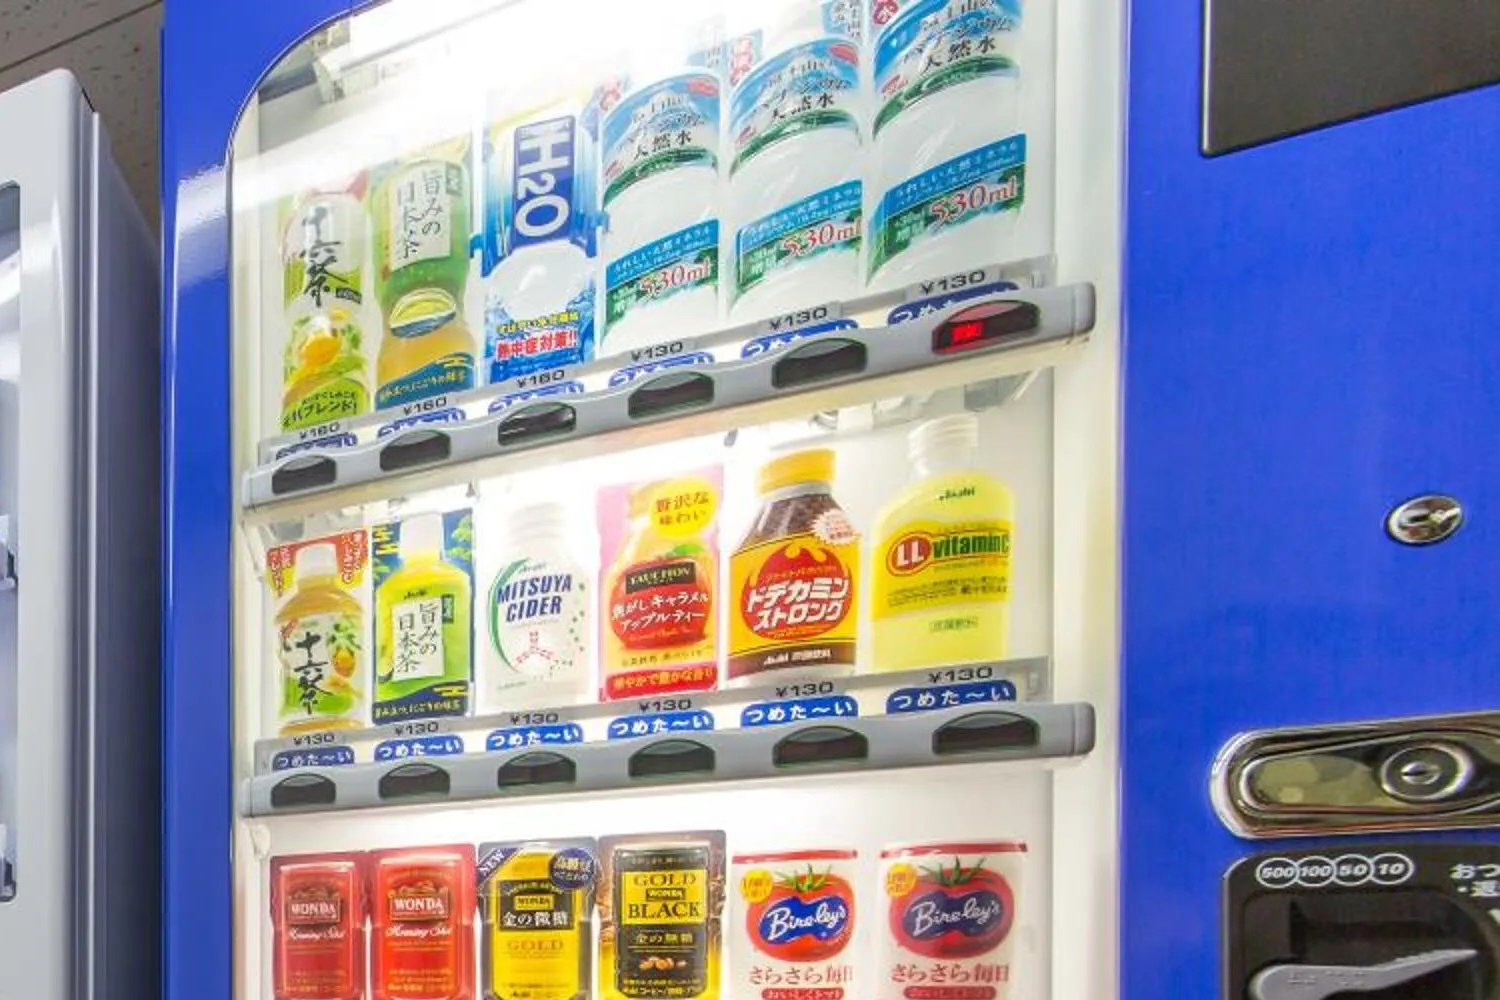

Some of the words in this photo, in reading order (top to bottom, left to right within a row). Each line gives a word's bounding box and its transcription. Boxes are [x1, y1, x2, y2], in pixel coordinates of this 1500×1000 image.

[515, 121, 571, 238] H2O
[931, 175, 1018, 221] 530ml
[301, 204, 348, 307] 十六茶
[920, 270, 986, 294] ¥130
[769, 307, 828, 331] ¥130
[631, 342, 683, 361] ¥130
[517, 370, 565, 388] ¥160
[403, 396, 448, 416] ¥160
[897, 541, 924, 566] LL
[497, 574, 574, 605] MITSUYA
[747, 577, 849, 613] ドデカミン
[506, 595, 563, 623] CIDER
[753, 599, 845, 632] ストロング
[419, 602, 440, 656] 旨みの
[396, 613, 421, 674] 日本茶
[293, 631, 335, 716] 十六茶
[928, 666, 993, 684] ¥130
[775, 682, 834, 698] ¥130
[639, 699, 692, 712] ¥130
[395, 721, 439, 736] ¥130
[509, 712, 559, 726] ¥130
[293, 733, 335, 747] ¥130
[479, 850, 505, 876] NEW
[1261, 866, 1294, 879] 500
[1300, 865, 1331, 878] 100
[1339, 864, 1368, 877] 50
[1378, 862, 1404, 875] 10
[634, 872, 697, 888] GOLD
[291, 902, 337, 918] WONDA
[393, 898, 445, 914] WONDA
[628, 902, 701, 919] BLACK
[891, 963, 1011, 985] さらさら毎日
